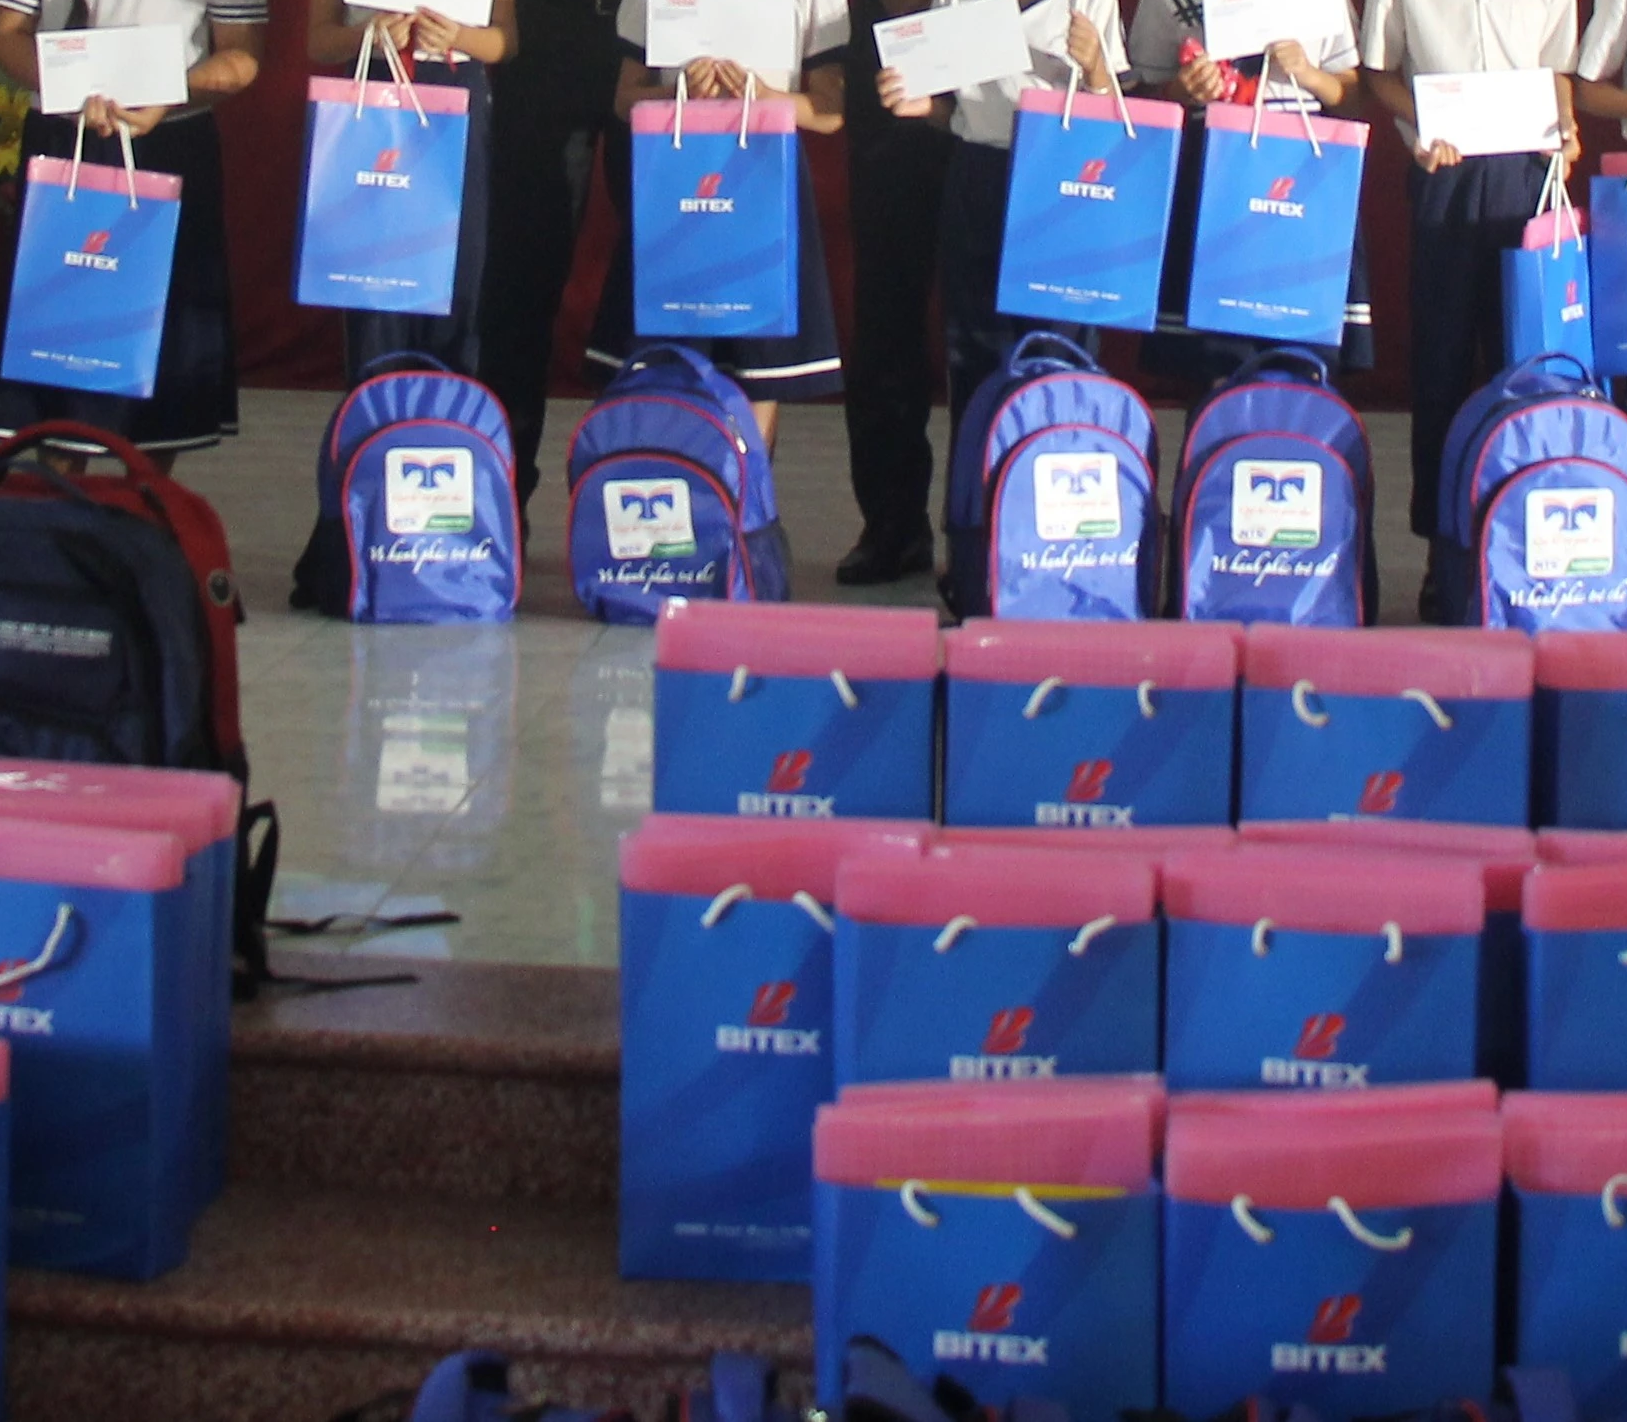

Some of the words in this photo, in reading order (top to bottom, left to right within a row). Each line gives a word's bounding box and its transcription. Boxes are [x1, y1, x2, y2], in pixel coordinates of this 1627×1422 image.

[356, 171, 410, 188] BITEX
[1060, 181, 1115, 200] BITEX
[680, 198, 733, 212] BITEX
[1249, 197, 1304, 217] BITEX
[64, 252, 118, 270] BITEX
[738, 794, 834, 816] BITEX
[1036, 804, 1134, 827] BITEX
[716, 1027, 816, 1053] BITEX
[950, 1057, 1056, 1079] BITEX
[1262, 1059, 1368, 1086] BITEX
[934, 1332, 1045, 1363] BITEX
[1272, 1345, 1384, 1372] BITEX
